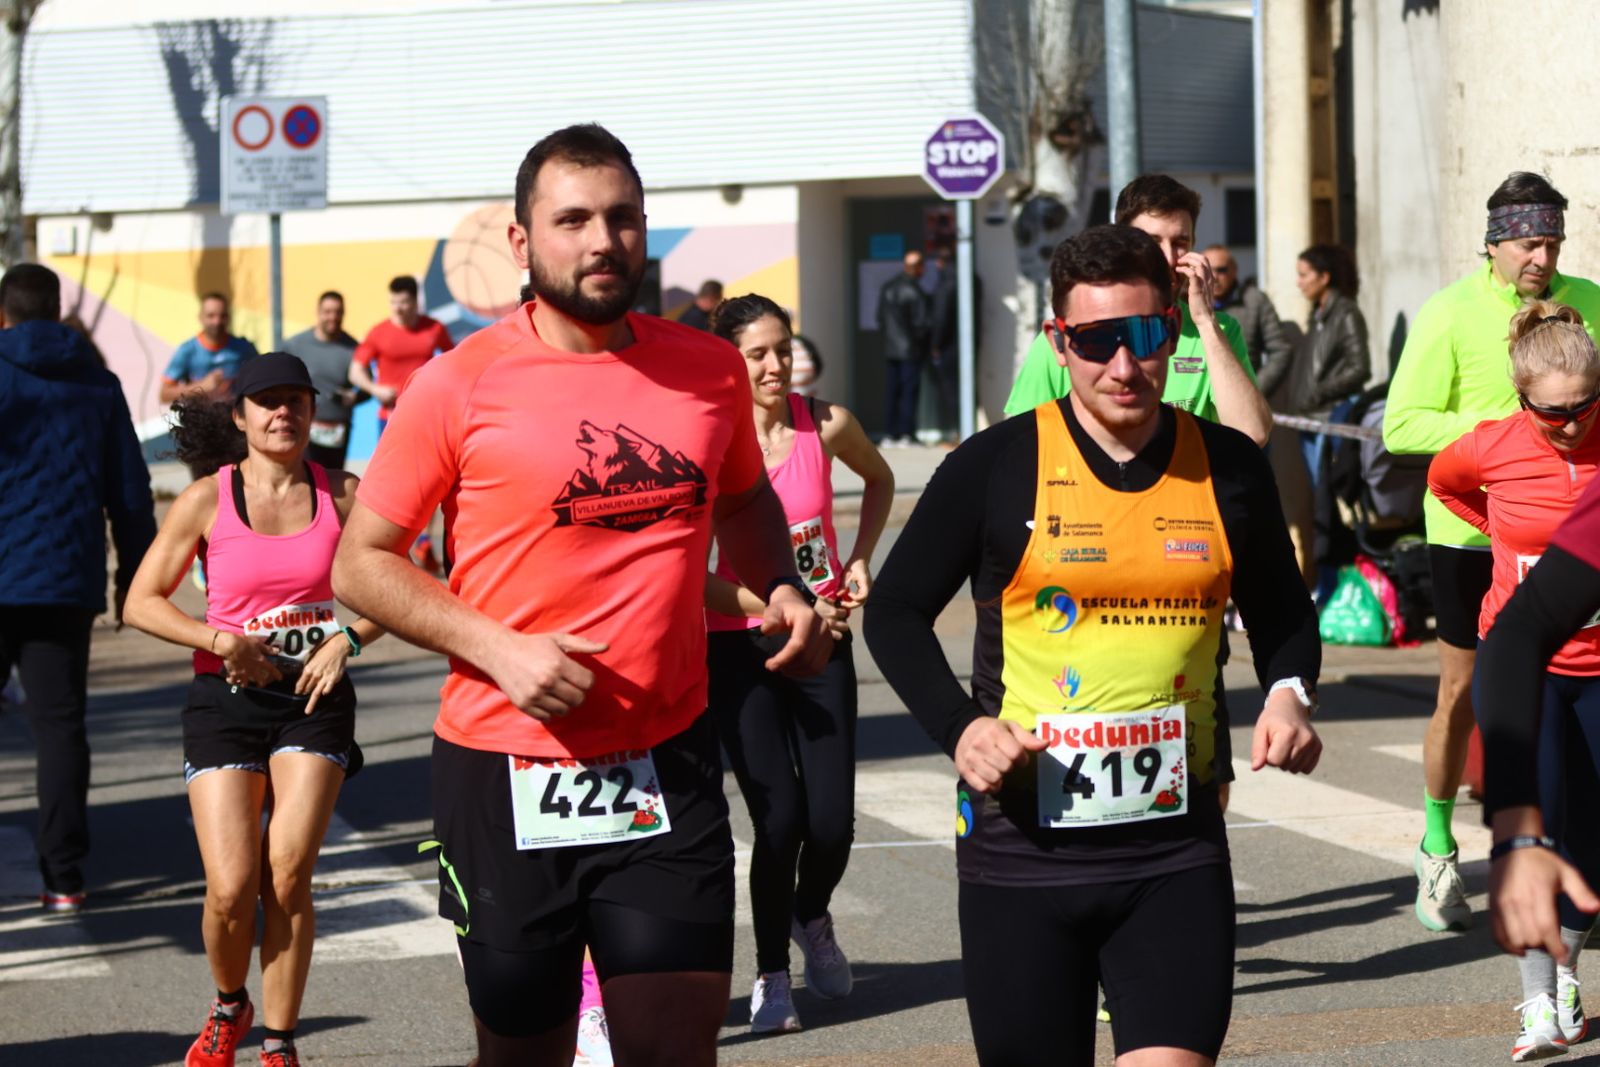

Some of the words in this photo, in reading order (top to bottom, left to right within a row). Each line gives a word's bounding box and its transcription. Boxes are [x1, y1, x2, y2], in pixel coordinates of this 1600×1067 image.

[928, 140, 997, 166] STOP
[607, 480, 663, 496] TRAIL
[576, 498, 636, 515] VILLANUEVA
[637, 496, 650, 506] DE
[1081, 597, 1148, 609] ESCUELA
[1100, 615, 1207, 626] SALMANTINA
[1041, 716, 1182, 749] bedunia
[1062, 748, 1162, 800] 419
[539, 766, 638, 819] 422
